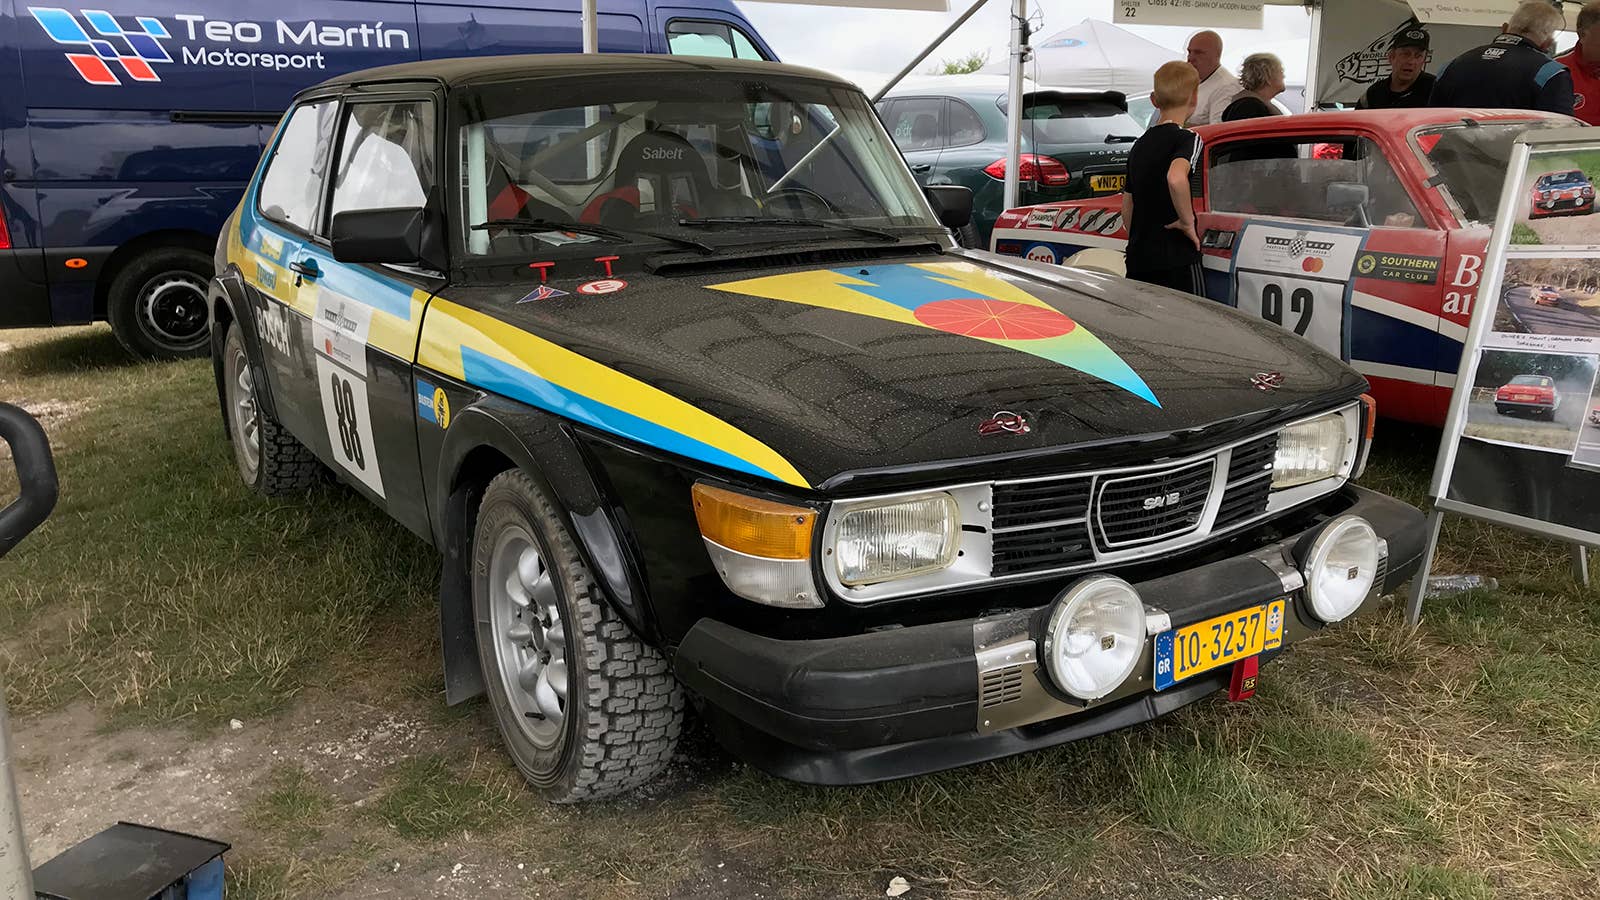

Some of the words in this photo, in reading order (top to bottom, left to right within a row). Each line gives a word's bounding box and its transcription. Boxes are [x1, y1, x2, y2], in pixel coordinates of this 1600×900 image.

[1125, 7, 1136, 17] 22
[175, 14, 262, 43] Teo
[276, 19, 409, 48] Martín
[182, 47, 325, 70] Motorsport
[642, 147, 683, 160] Sabelt
[1097, 176, 1118, 188] VN12
[1031, 214, 1055, 222] CHAMPION
[1381, 256, 1438, 269] SOUTHERN
[1405, 273, 1429, 281] CLUB
[1451, 254, 1484, 289] B
[1262, 283, 1314, 337] 92
[256, 305, 291, 357] BOSCH
[331, 372, 365, 471] 88
[1143, 492, 1180, 510] SAAB
[1158, 658, 1171, 675] GR
